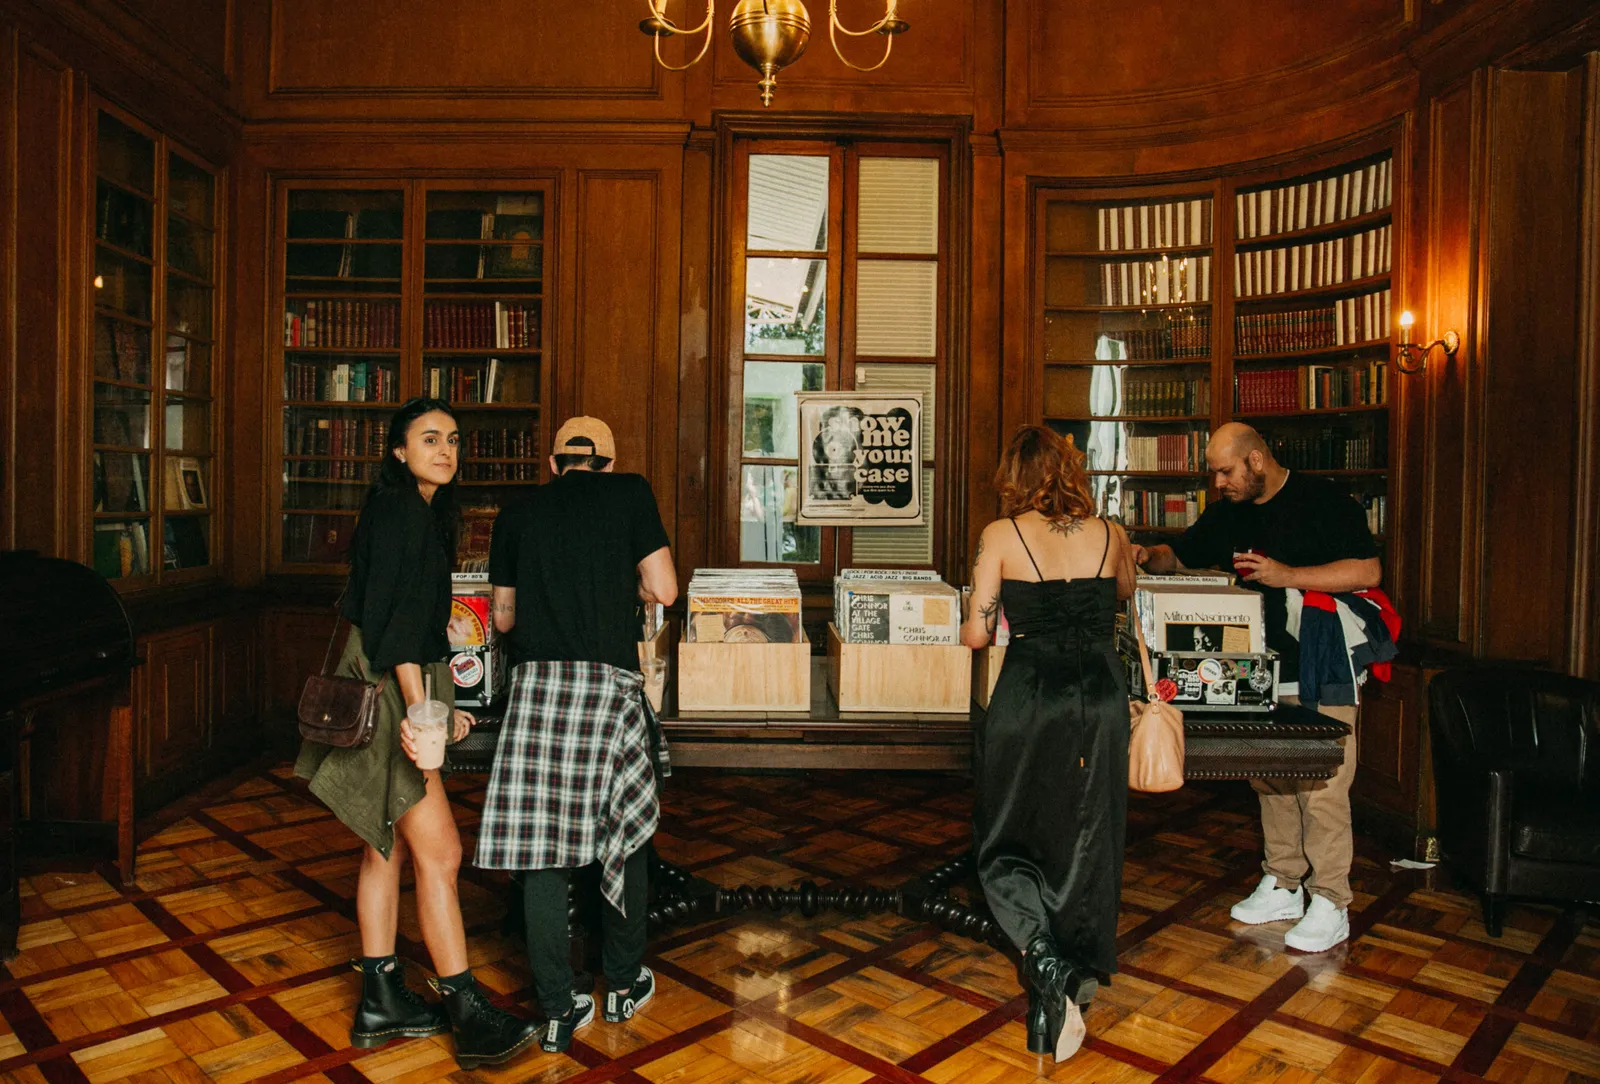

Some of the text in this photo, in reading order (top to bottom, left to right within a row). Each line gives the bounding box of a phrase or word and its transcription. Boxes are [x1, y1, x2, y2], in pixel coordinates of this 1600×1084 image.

[862, 430, 910, 447] me
[853, 449, 912, 468] your
[854, 468, 909, 483] case
[852, 594, 875, 602] CHRIS
[454, 603, 473, 617] KATY
[851, 602, 888, 610] CONNOR
[851, 617, 881, 625] VILLAGE
[1163, 611, 1251, 623] Milton Nascimento
[471, 618, 483, 643] PERRY
[851, 624, 871, 632] GATE
